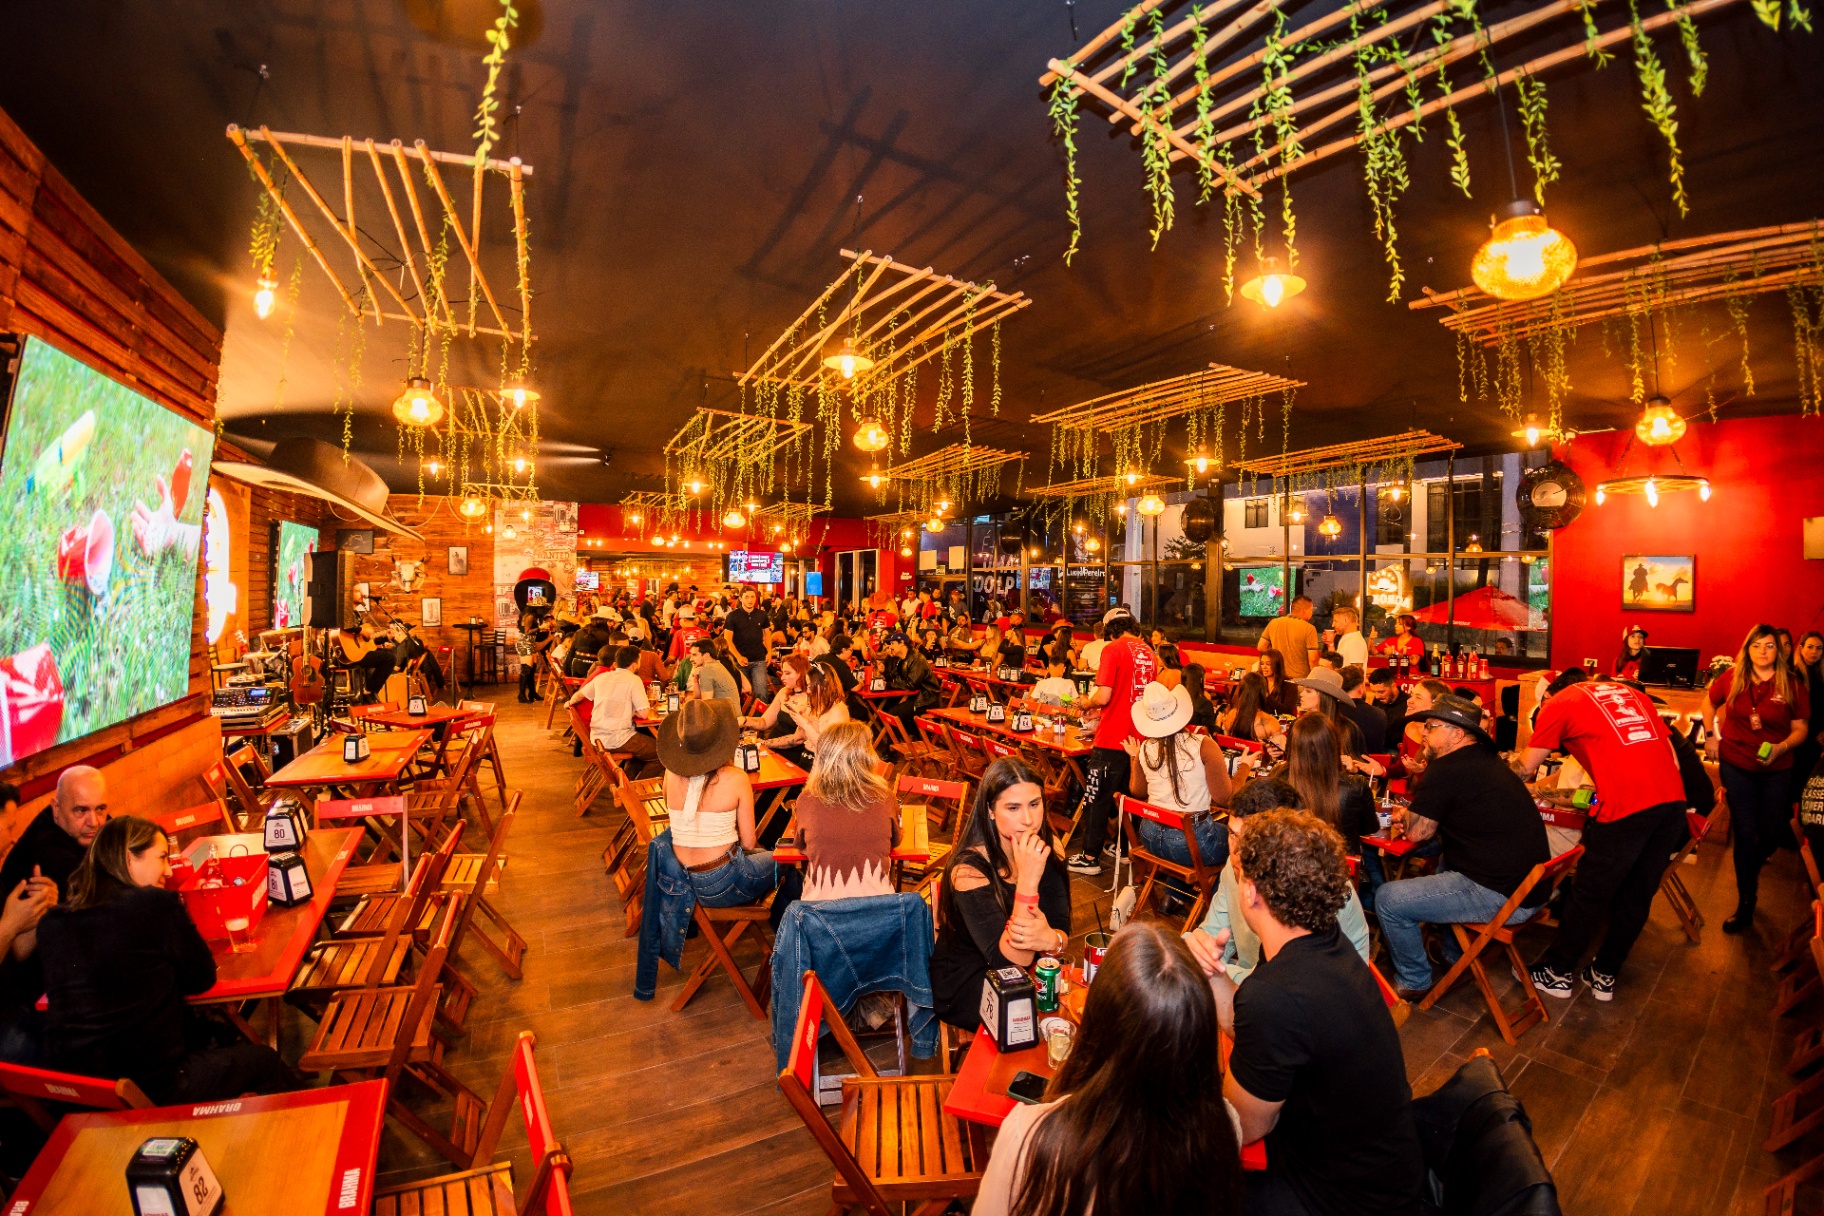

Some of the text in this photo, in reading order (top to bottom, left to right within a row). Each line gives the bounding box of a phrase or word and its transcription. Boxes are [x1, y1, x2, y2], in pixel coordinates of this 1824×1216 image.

[274, 828, 285, 839] 80
[986, 997, 994, 1019] 78
[192, 1102, 242, 1117] BRAHMA
[193, 1176, 209, 1206] 82
[338, 1167, 361, 1209] BRAHMA
